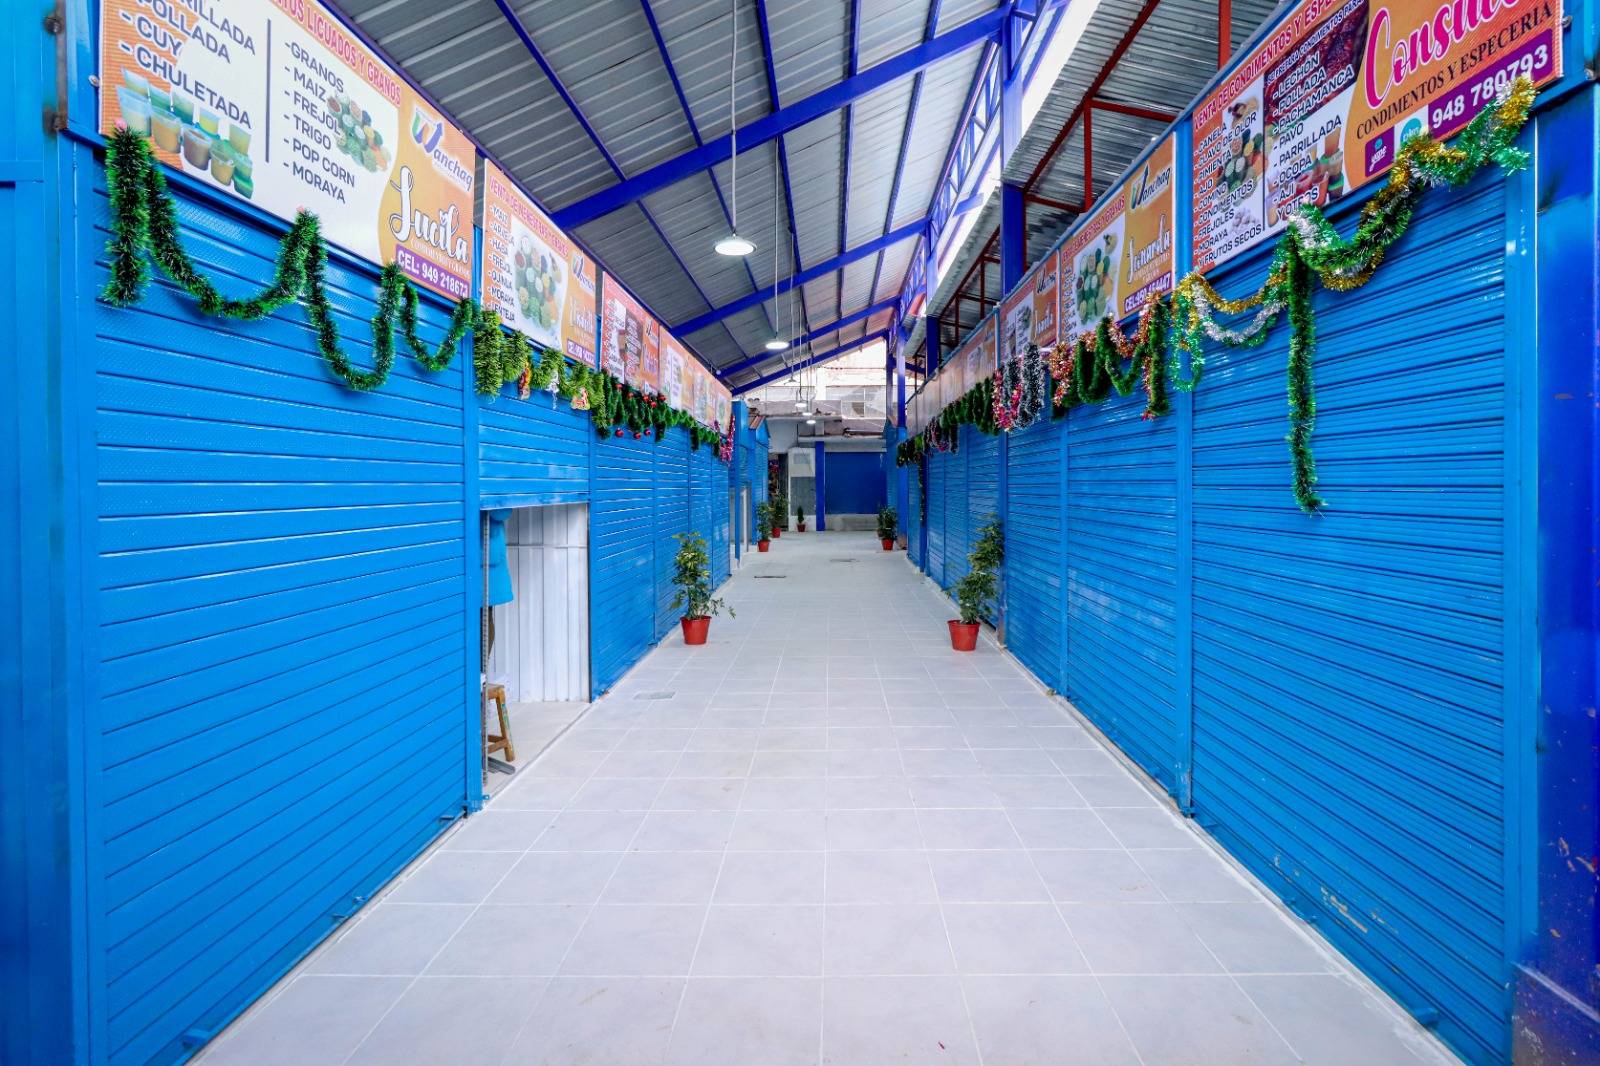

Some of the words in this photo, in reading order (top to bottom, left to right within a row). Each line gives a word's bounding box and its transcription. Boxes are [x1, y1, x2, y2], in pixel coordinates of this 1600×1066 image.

[307, 6, 355, 67] LICUADOS
[367, 61, 401, 105] GRANOS
[1299, 11, 1343, 56] CONDIMENTOS
[137, 46, 252, 129] CHULETADA
[1195, 99, 1216, 130] VENTA
[1229, 26, 1292, 98] CONDIMENTOS
[1294, 14, 1302, 36] Y
[1356, 76, 1444, 140] CONDIMENTOS
[1447, 61, 1456, 82] Y
[1460, 2, 1553, 74] ESPECERIA
[1279, 66, 1354, 129] PACHAMANCA
[1431, 94, 1465, 129] 948
[293, 114, 331, 150] TRIGO
[1280, 115, 1342, 166] PARRILLADA
[292, 138, 320, 164] POP
[322, 152, 355, 188] CORN
[292, 161, 346, 203] MORAYA
[1204, 240, 1233, 265] FRUTOS
[1234, 224, 1262, 248] SECOS
[421, 262, 439, 284] 949
